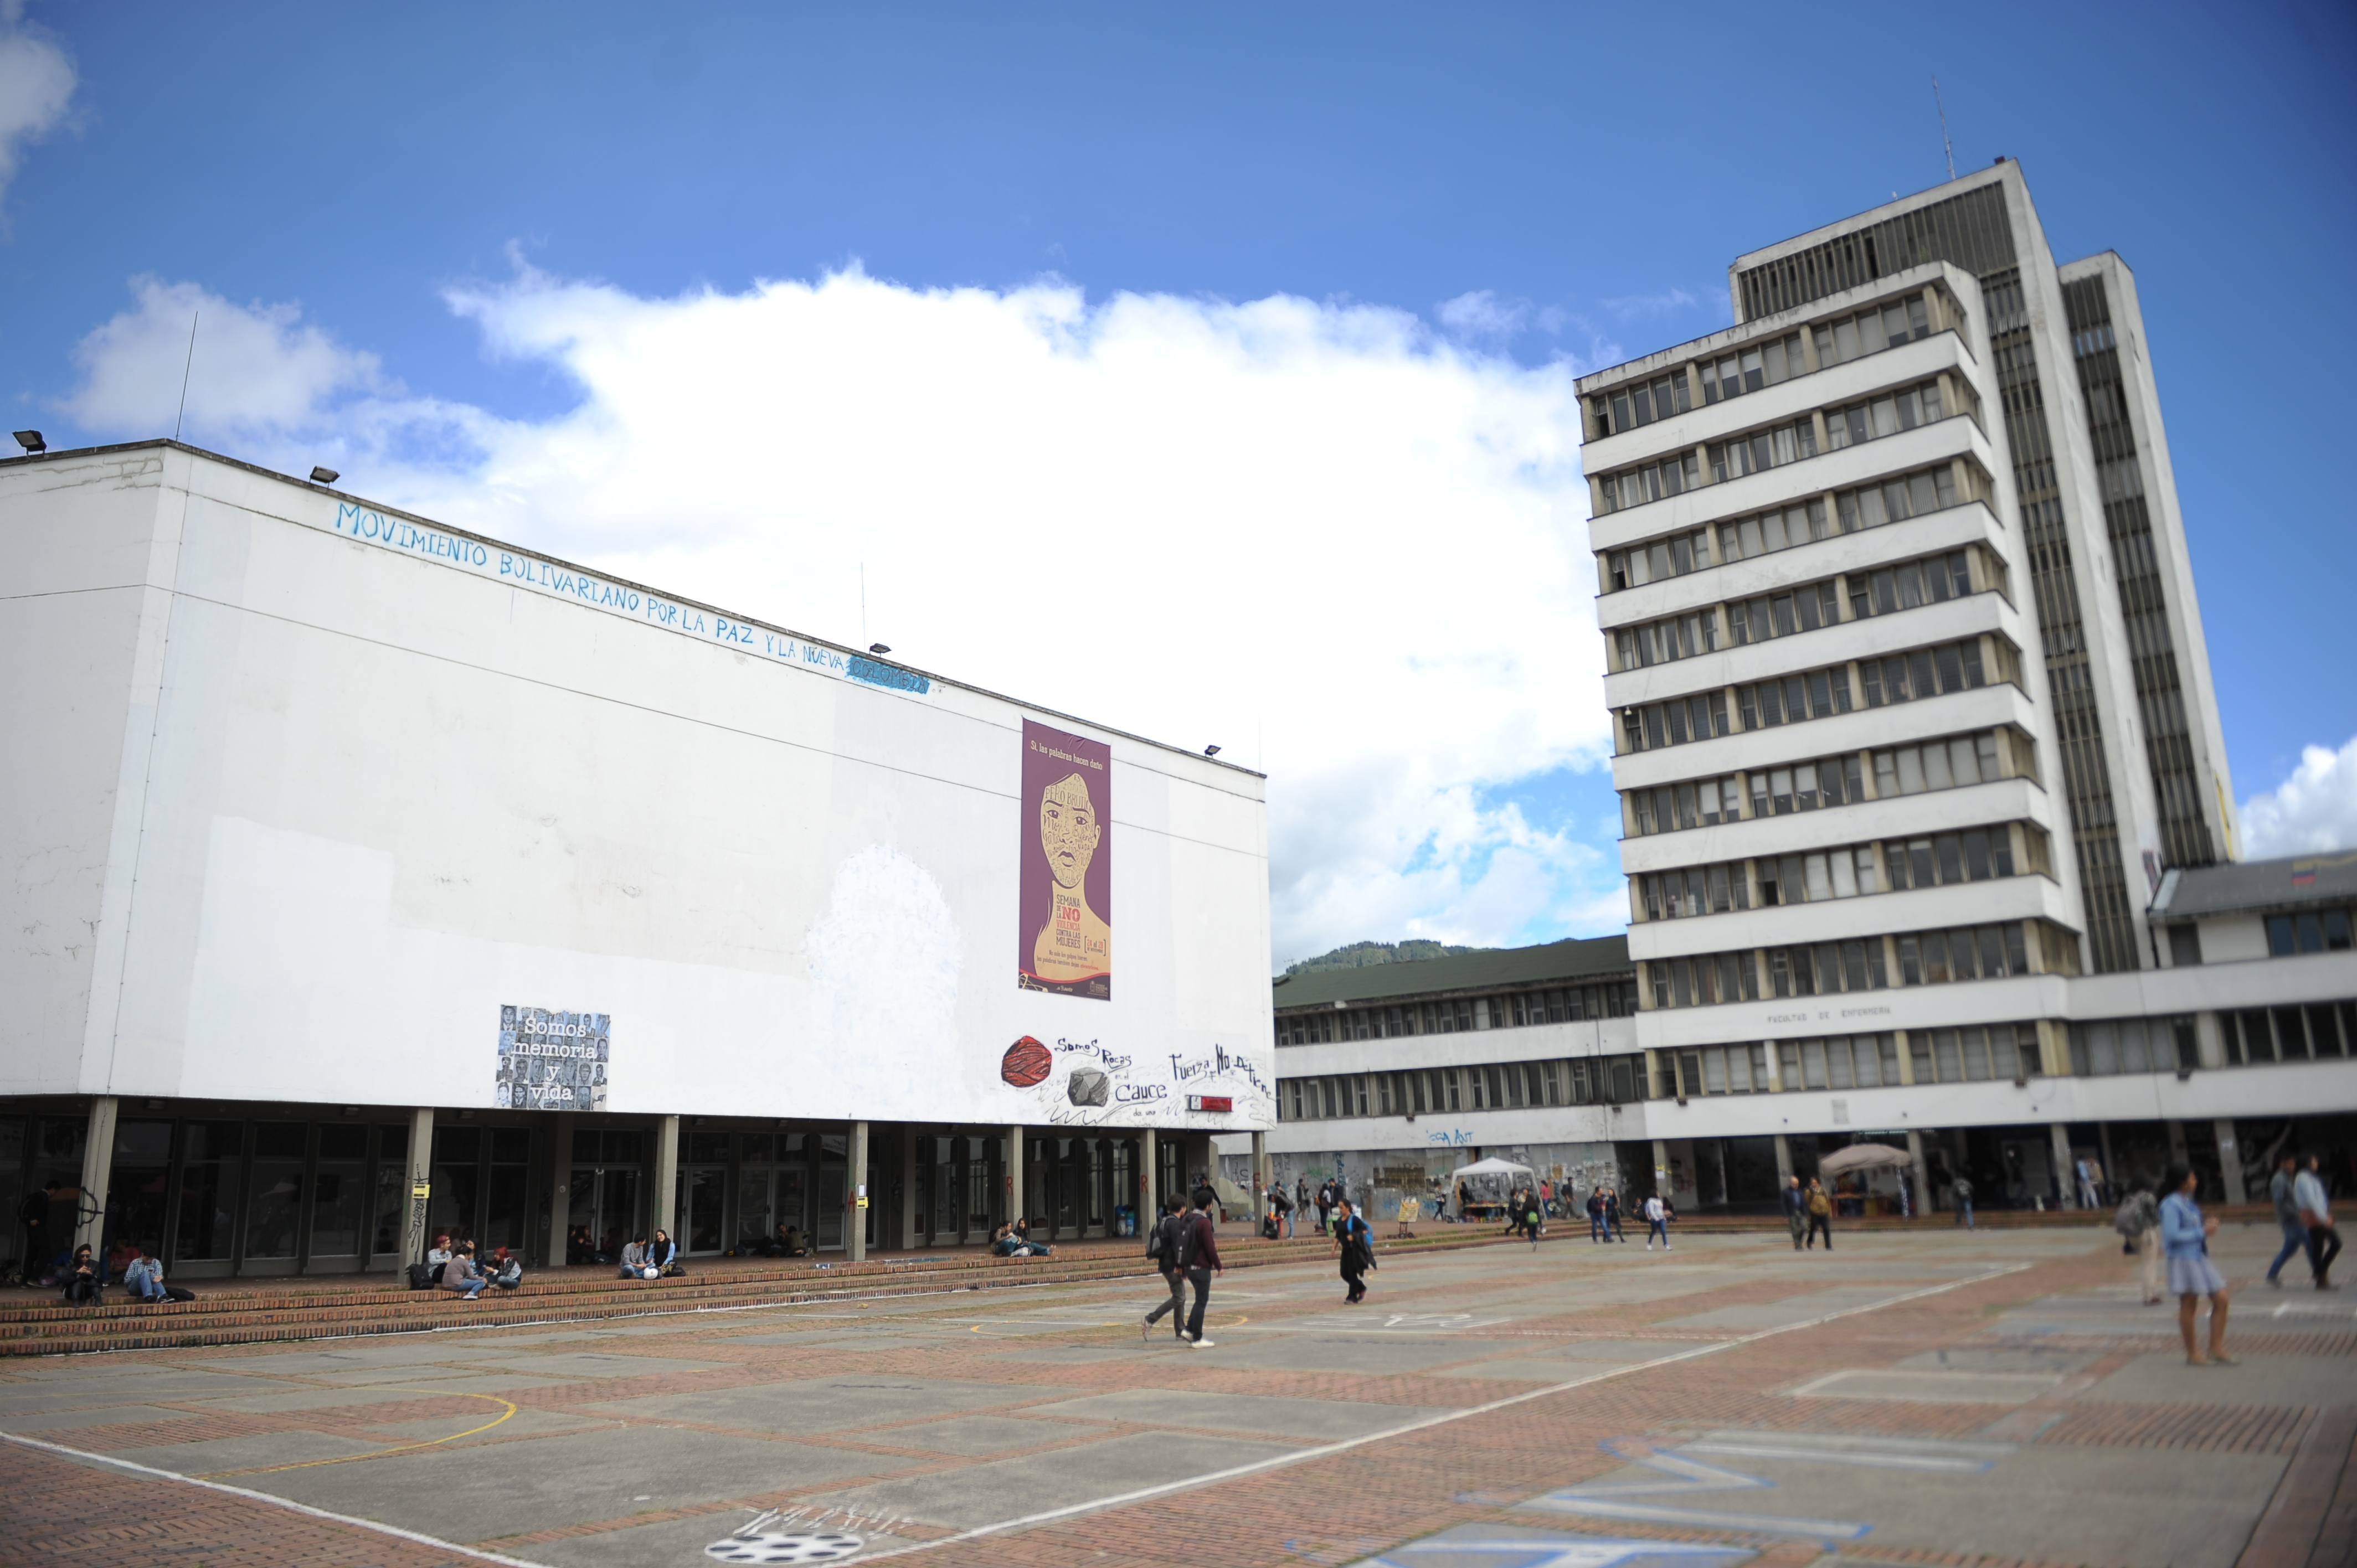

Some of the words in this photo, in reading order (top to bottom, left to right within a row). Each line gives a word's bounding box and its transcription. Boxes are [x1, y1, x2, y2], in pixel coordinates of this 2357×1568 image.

[336, 502, 487, 566] MOVIMIENTO
[500, 553, 639, 611] BOLIVARIANO
[647, 597, 677, 626] POR
[682, 610, 705, 633] LA
[717, 618, 753, 644] PAZ
[765, 635, 774, 654] Y
[779, 638, 796, 658] LA
[803, 645, 845, 671] NUEVA
[852, 661, 926, 692] COLOMBIA
[1039, 742, 1048, 754] las
[1049, 747, 1072, 762] palabras
[1073, 753, 1089, 766] hacen
[1045, 785, 1065, 803] PERO
[1056, 894, 1080, 908] SEMANA
[1062, 906, 1080, 922] NO
[1056, 919, 1080, 932] VIOLENCIA
[1056, 928, 1072, 938] CONTRA
[1072, 930, 1080, 940] LAS
[1056, 936, 1081, 949] MUJERES
[1819, 1012, 1830, 1020] DE
[524, 1018, 586, 1038] Somos
[511, 1042, 598, 1059] memoria
[1054, 1038, 1099, 1058] Somos
[1102, 1049, 1132, 1071] Rocas
[546, 1065, 561, 1081] y
[530, 1082, 574, 1101] vida
[1115, 1084, 1167, 1102] Cauce
[1006, 1176, 1013, 1196] R
